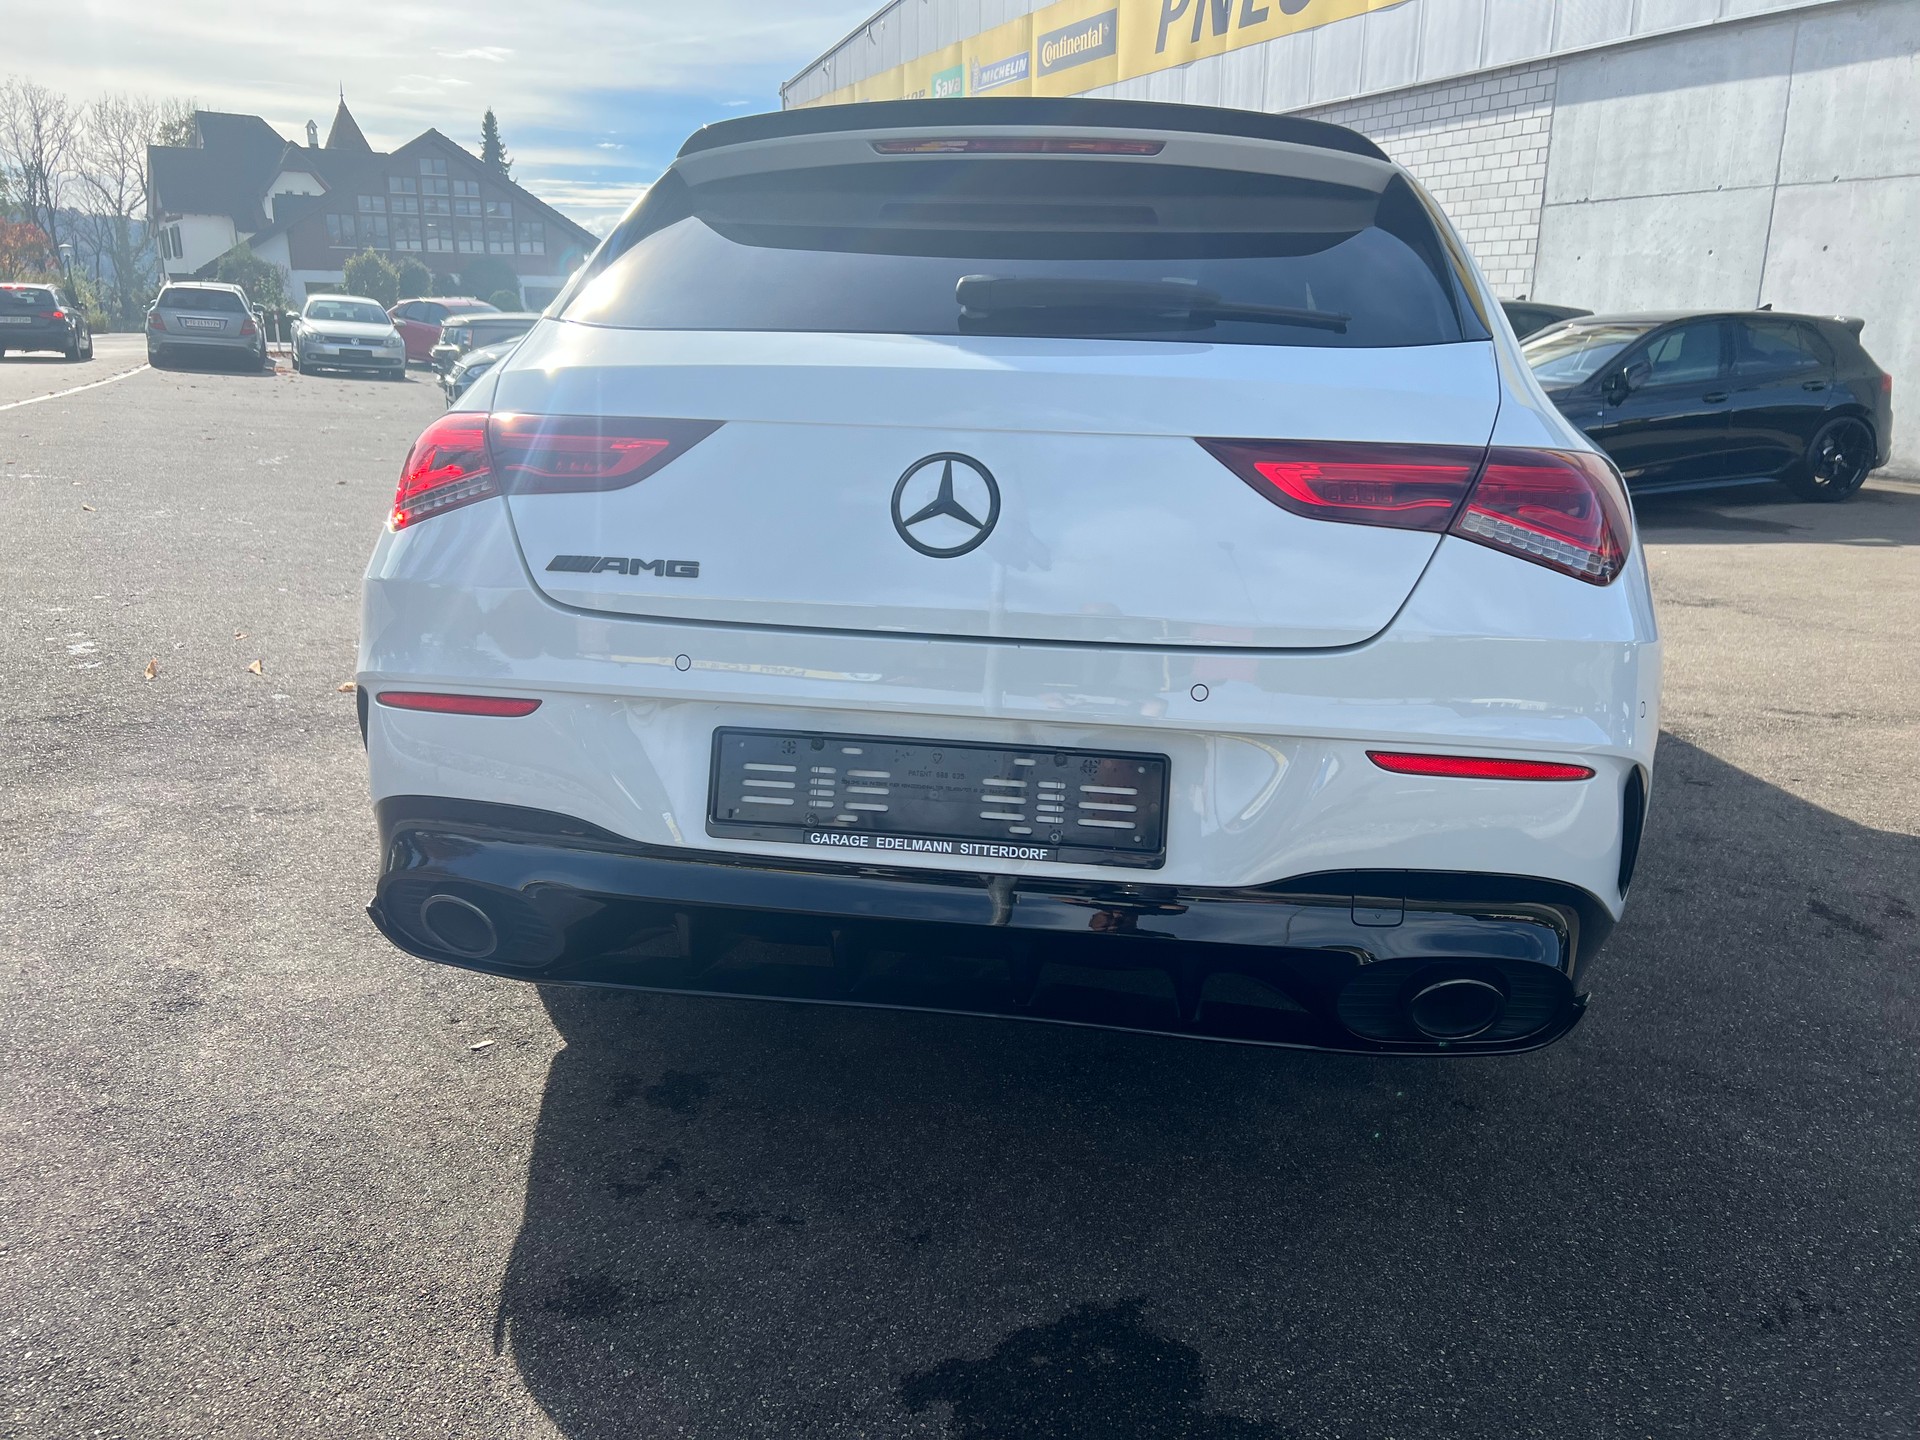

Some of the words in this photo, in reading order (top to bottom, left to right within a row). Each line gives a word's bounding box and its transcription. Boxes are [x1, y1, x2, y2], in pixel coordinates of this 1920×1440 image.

[1041, 22, 1103, 68] Continental
[980, 57, 1028, 85] MICHELIN
[934, 77, 961, 98] Sava
[591, 556, 700, 579] AMG
[907, 769, 933, 777] PATENT
[809, 832, 869, 848] GARAGE
[875, 837, 953, 854] EDELMANN
[959, 842, 1049, 861] SITTERDORF
